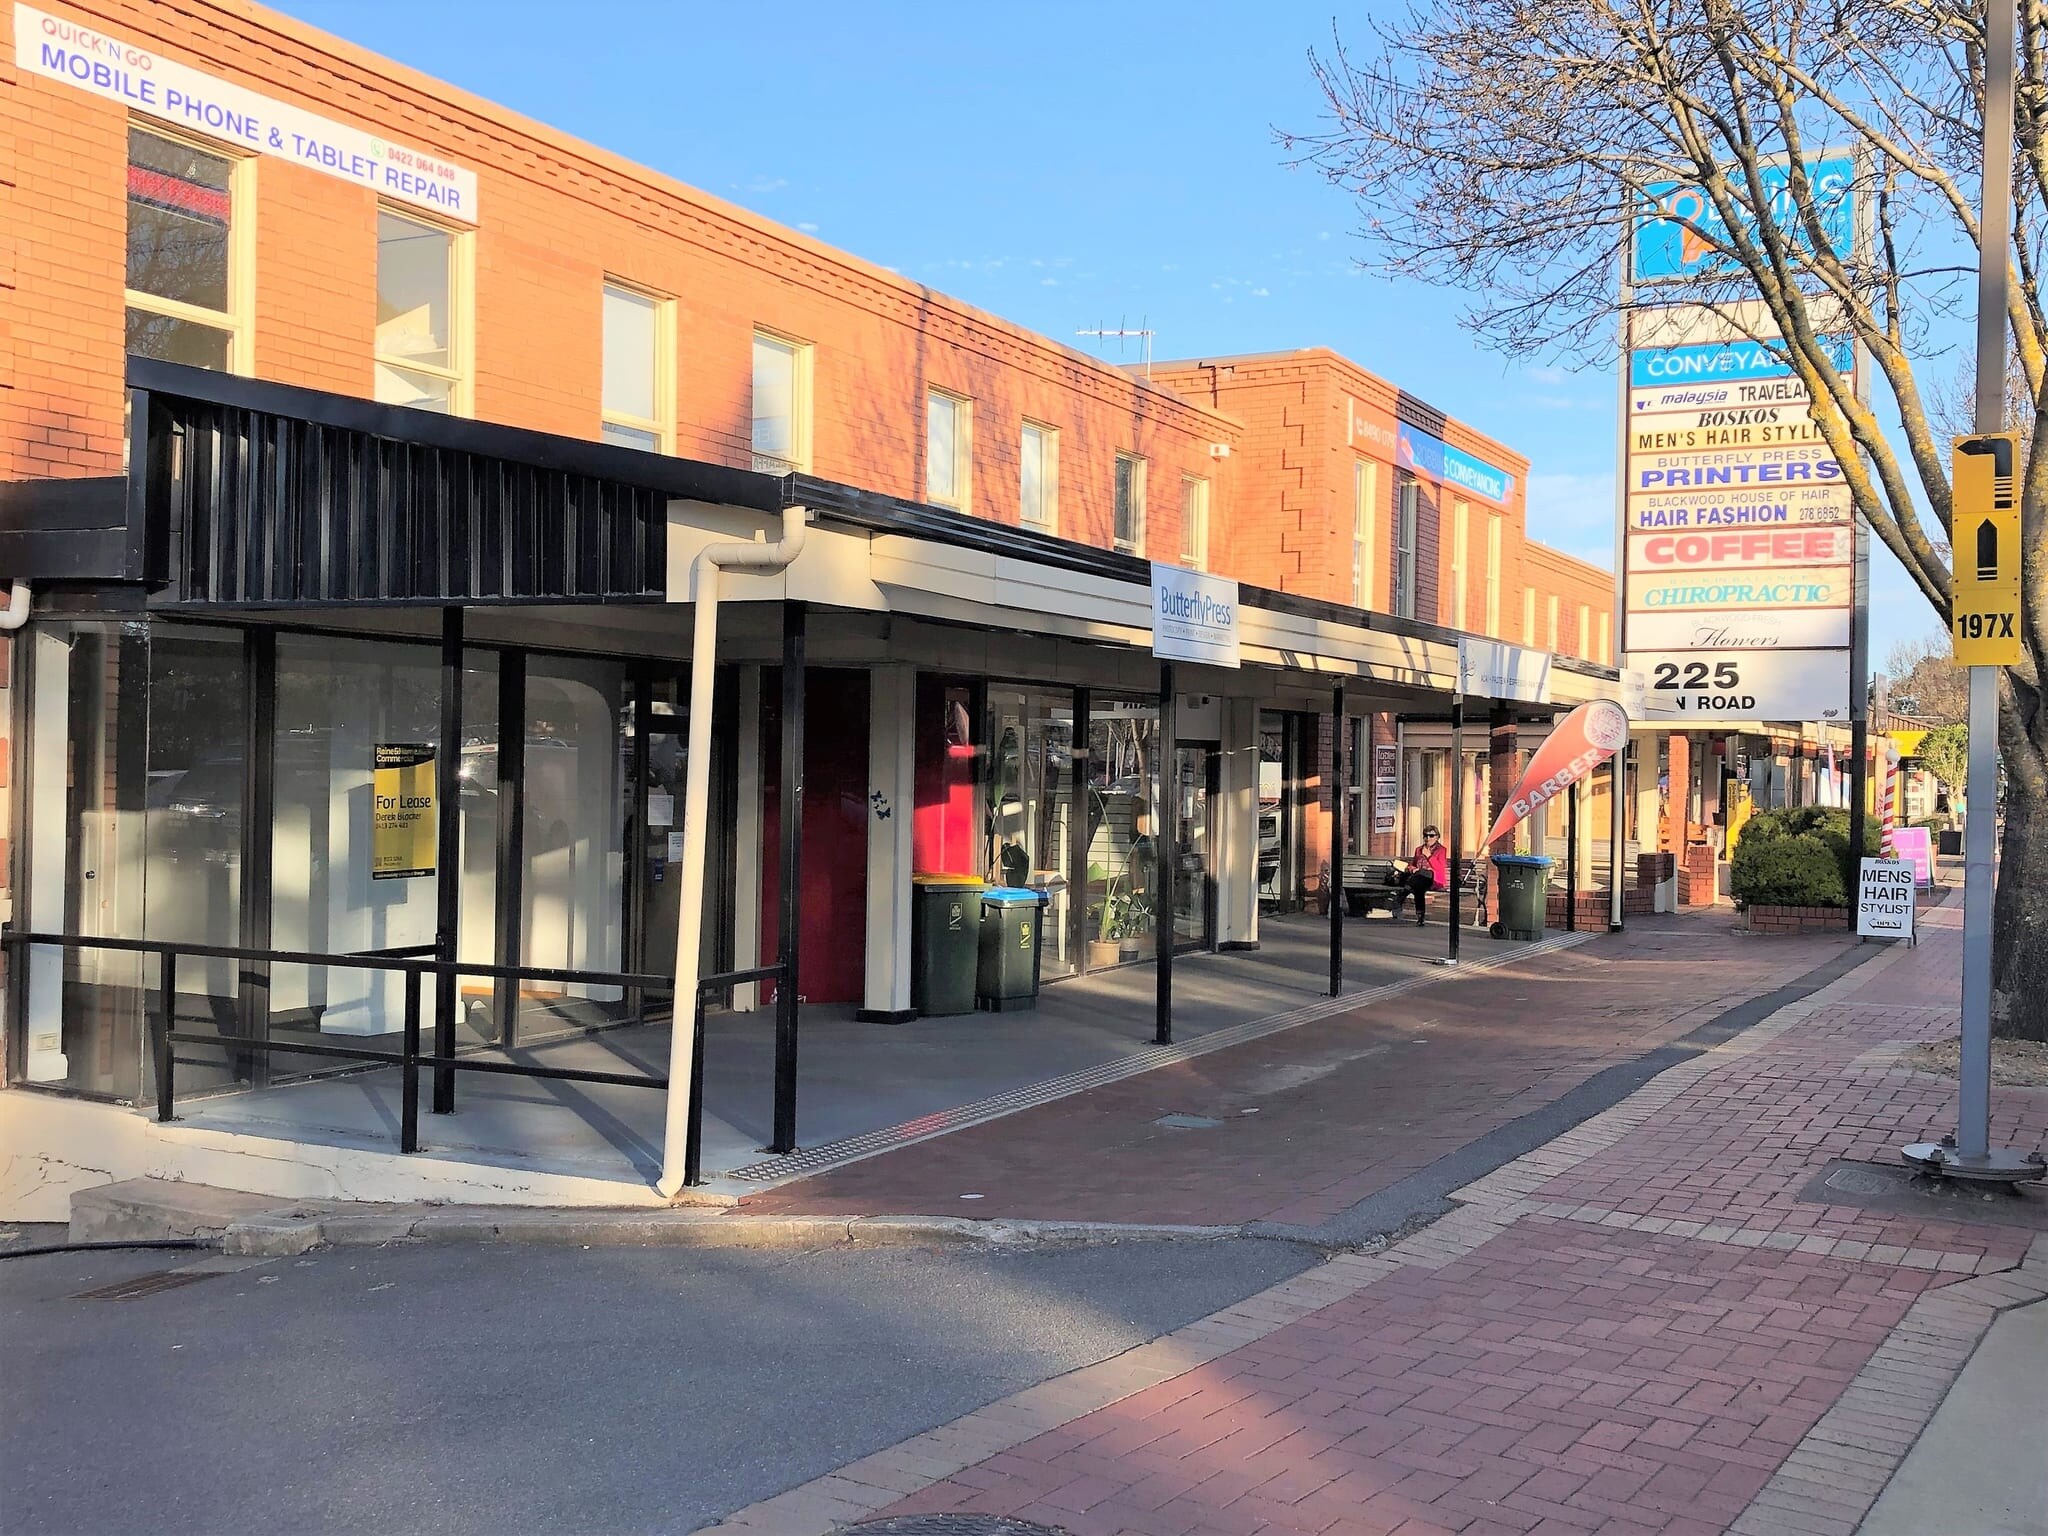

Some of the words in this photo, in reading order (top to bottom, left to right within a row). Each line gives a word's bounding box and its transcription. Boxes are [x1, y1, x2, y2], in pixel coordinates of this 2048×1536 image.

[42, 18, 121, 61] QUICK'N
[125, 49, 153, 72] GO
[42, 43, 156, 105] MOBILE
[167, 88, 260, 141] PHONE
[268, 126, 284, 150] &
[291, 133, 378, 181] TABLET
[385, 166, 460, 209] REPAIR
[388, 147, 413, 166] 0422
[416, 159, 434, 174] 064
[1661, 388, 1728, 406] malaysia
[1739, 381, 1808, 402] TRAVELA
[1697, 408, 1780, 428] BOSKOS
[1639, 431, 1695, 449] MEN'S
[1706, 428, 1751, 445] HAIR
[1658, 452, 1753, 468] BUTTERFLY
[1763, 448, 1822, 462] PRESS
[1449, 458, 1501, 499] CONVEYANCING
[1641, 460, 1842, 488] PRINTERS
[1649, 494, 1725, 508] BLACKWOOD
[1731, 491, 1772, 504] HOUSE
[1779, 490, 1796, 502] OF
[1802, 489, 1830, 500] HAIR
[1640, 509, 1688, 527] HAIR
[1696, 504, 1788, 526] FASHION
[1799, 507, 1815, 521] 278
[1817, 506, 1840, 519] 6852
[1644, 532, 1835, 564] COFFEE
[1161, 585, 1231, 626] ButterflyPress
[1644, 584, 1831, 607] CHIROPRACTIC
[1690, 627, 1780, 647] Flowers
[1957, 613, 2015, 639] 197X
[1654, 662, 1740, 690] 225
[1697, 695, 1756, 710] ROAD
[1512, 748, 1606, 819] BARBER
[376, 795, 396, 809] For
[400, 795, 431, 809] Lease
[376, 812, 396, 822] Derek
[1862, 869, 1912, 884] MENS
[1864, 886, 1909, 901] HAIR
[1860, 902, 1912, 915] STYLIST
